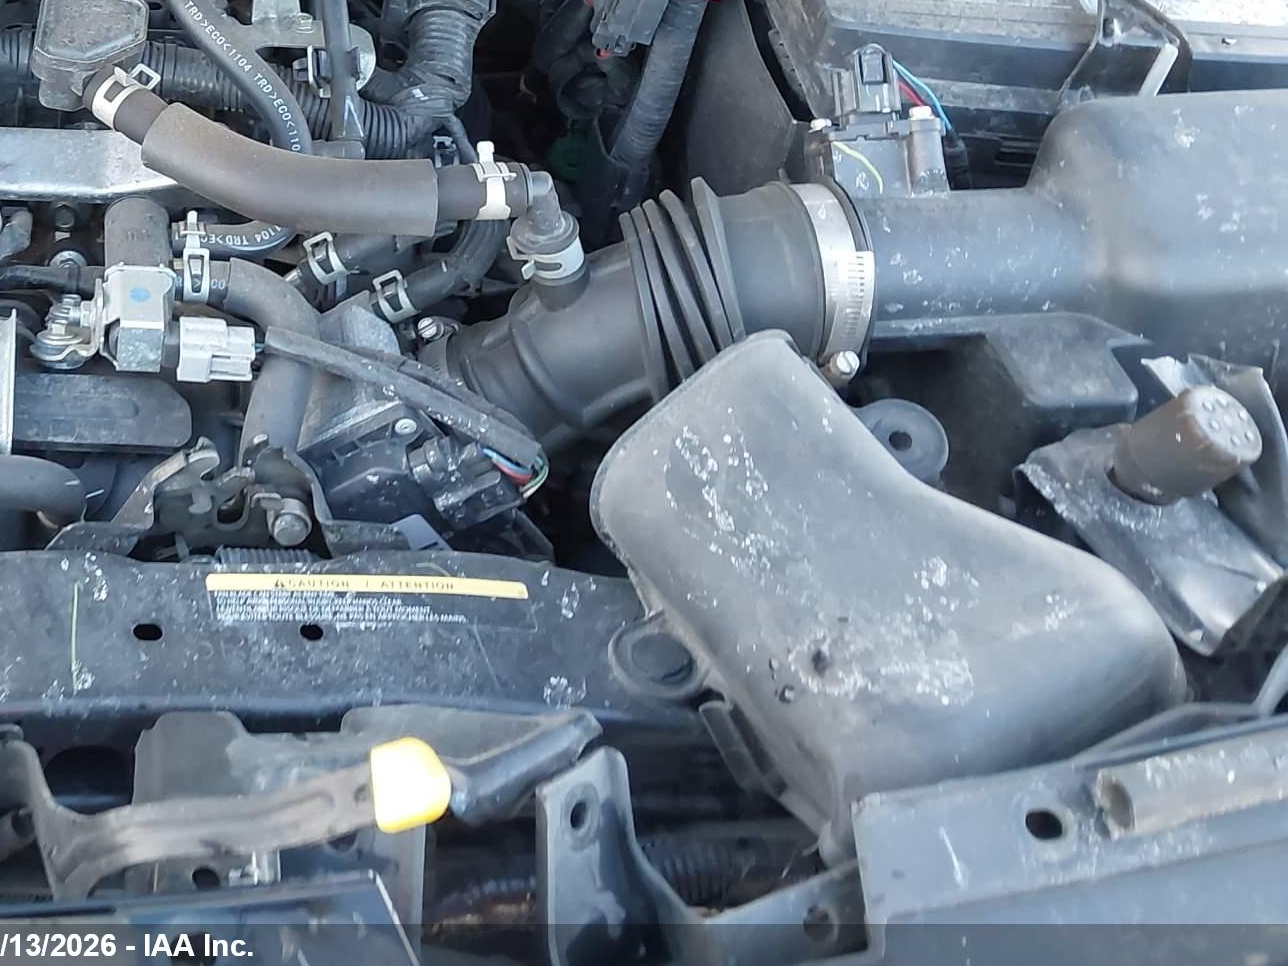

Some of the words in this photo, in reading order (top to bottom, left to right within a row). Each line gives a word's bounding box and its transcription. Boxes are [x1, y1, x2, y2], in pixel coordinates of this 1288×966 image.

[184, 0, 254, 72] TRD>ECO<1104
[253, 72, 301, 152] TRD>ECO<110
[288, 578, 350, 589] CAUTION
[380, 581, 456, 591] ATTENTION
